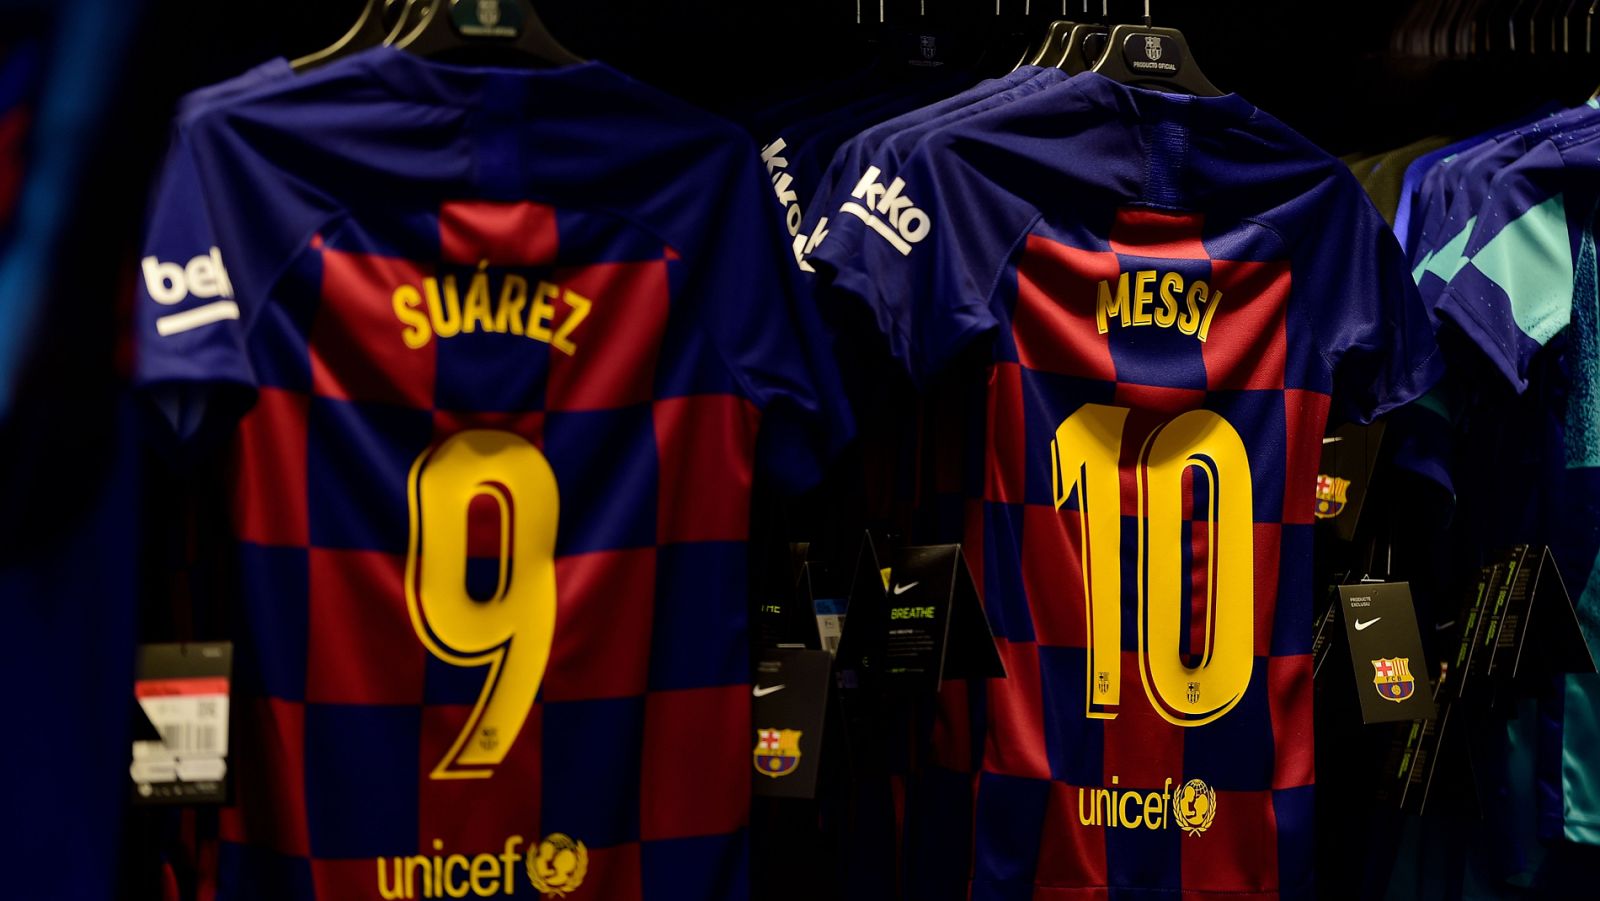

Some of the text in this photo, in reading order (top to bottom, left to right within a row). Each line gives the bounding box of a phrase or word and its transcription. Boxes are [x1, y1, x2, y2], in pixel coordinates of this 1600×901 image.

[391, 258, 593, 357] SUÁREZ
[1096, 270, 1223, 343] MESSI
[1051, 403, 1254, 727] 10
[405, 429, 560, 780] 9
[890, 606, 936, 620] BREATHE
[1078, 775, 1173, 830] unicef
[376, 834, 525, 900] unicef
